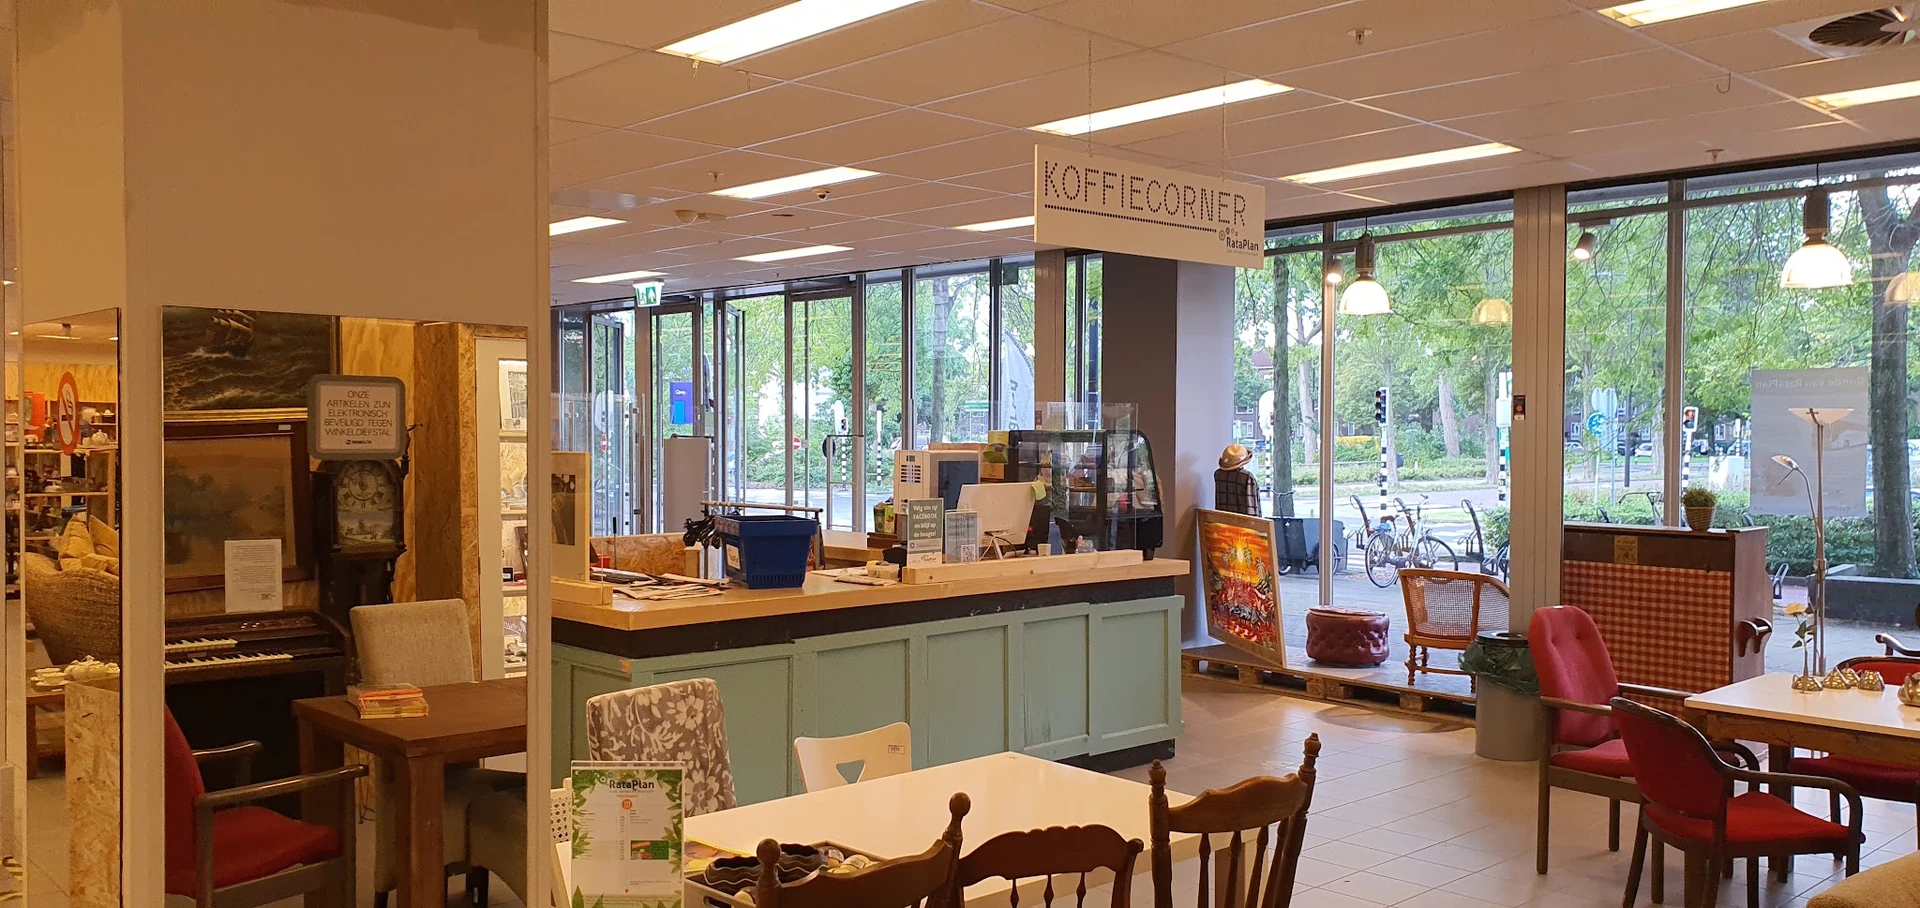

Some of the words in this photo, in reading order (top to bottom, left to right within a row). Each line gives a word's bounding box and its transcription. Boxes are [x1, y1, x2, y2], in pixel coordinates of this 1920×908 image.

[1044, 160, 1246, 227] KOFFIECORNER
[1226, 236, 1259, 252] RataPlan
[347, 390, 370, 399] ONZE
[326, 399, 370, 408] ARTIKELEN
[328, 409, 388, 418] ELEKTRONISCH
[368, 419, 393, 427] TEGEN
[325, 428, 392, 437] WINKELDIEFSTAL
[609, 779, 655, 789] RataPlan
